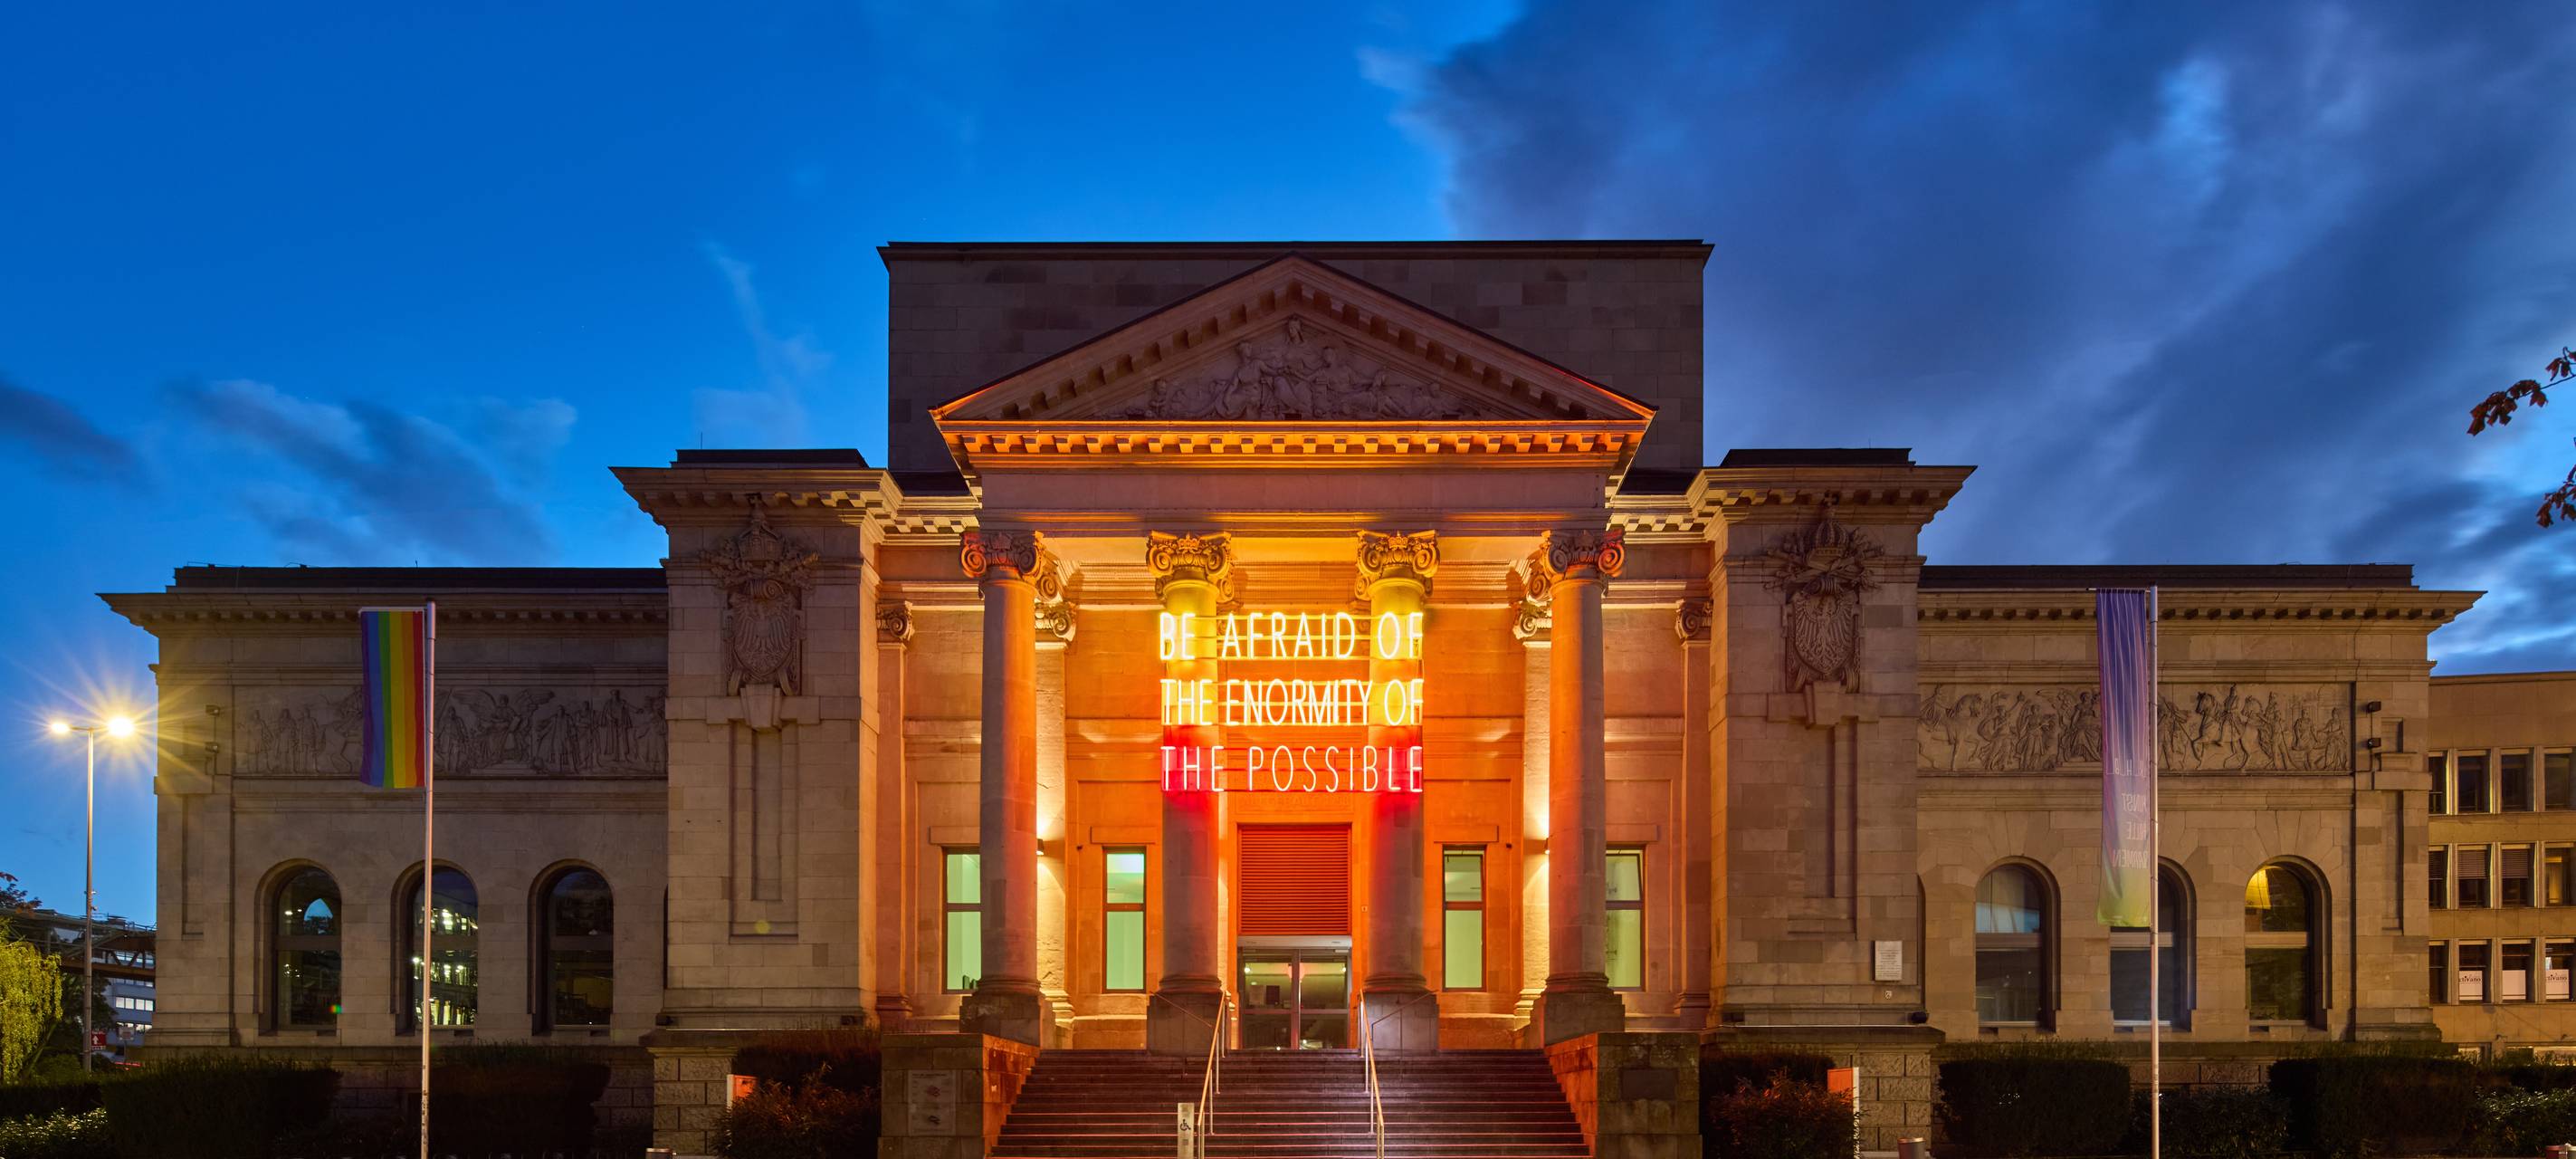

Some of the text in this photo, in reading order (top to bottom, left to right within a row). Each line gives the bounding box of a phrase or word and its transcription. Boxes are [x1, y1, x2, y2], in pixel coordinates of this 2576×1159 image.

[1159, 612, 1423, 660] BE AFRAID OF
[1160, 679, 1424, 725] THE ENORMITY OF
[1160, 745, 1423, 792] THE POSSIBLE
